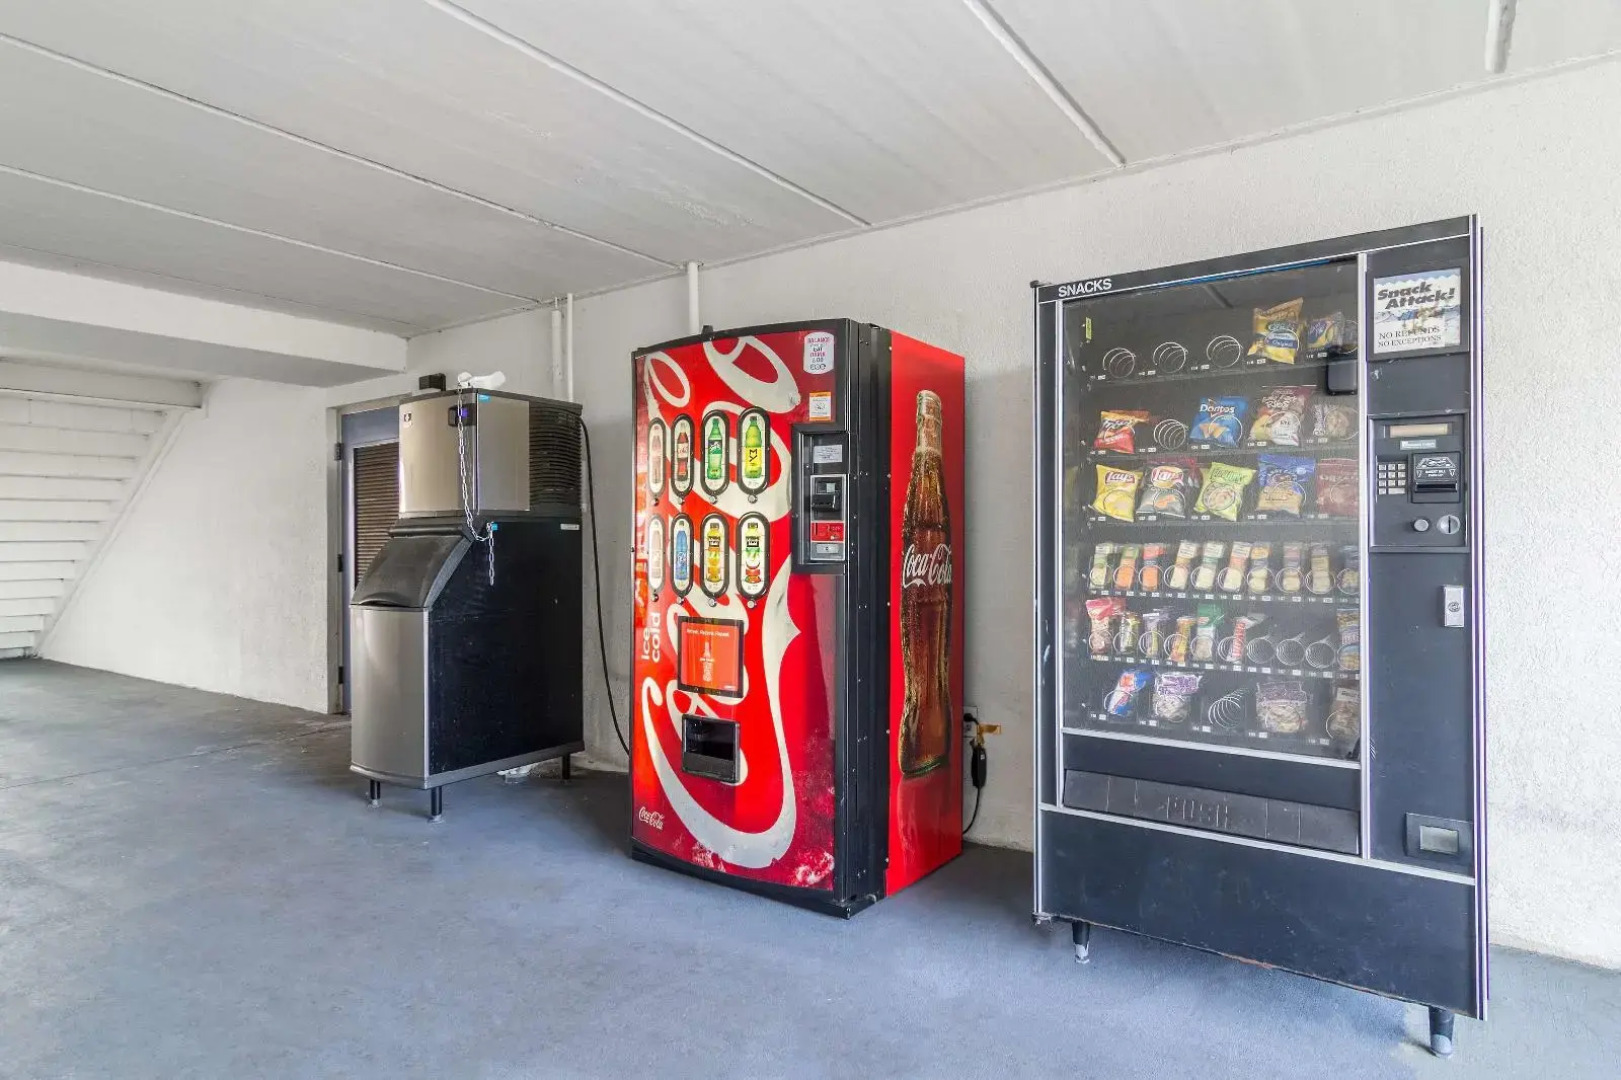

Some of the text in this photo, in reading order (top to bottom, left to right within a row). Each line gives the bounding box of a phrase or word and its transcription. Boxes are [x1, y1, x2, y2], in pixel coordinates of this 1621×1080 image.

[1058, 277, 1112, 298] SNACKS
[1377, 281, 1433, 301] Snack
[1385, 287, 1456, 310] Attack!
[1378, 325, 1440, 340] NO REFUNDS
[1391, 335, 1442, 346] EXCEPTIONS
[1199, 403, 1236, 413] Doritos
[902, 543, 952, 589] Coca-Cola
[640, 627, 651, 661] Ice
[651, 611, 662, 663] cold
[638, 805, 665, 831] Coca-Cola
